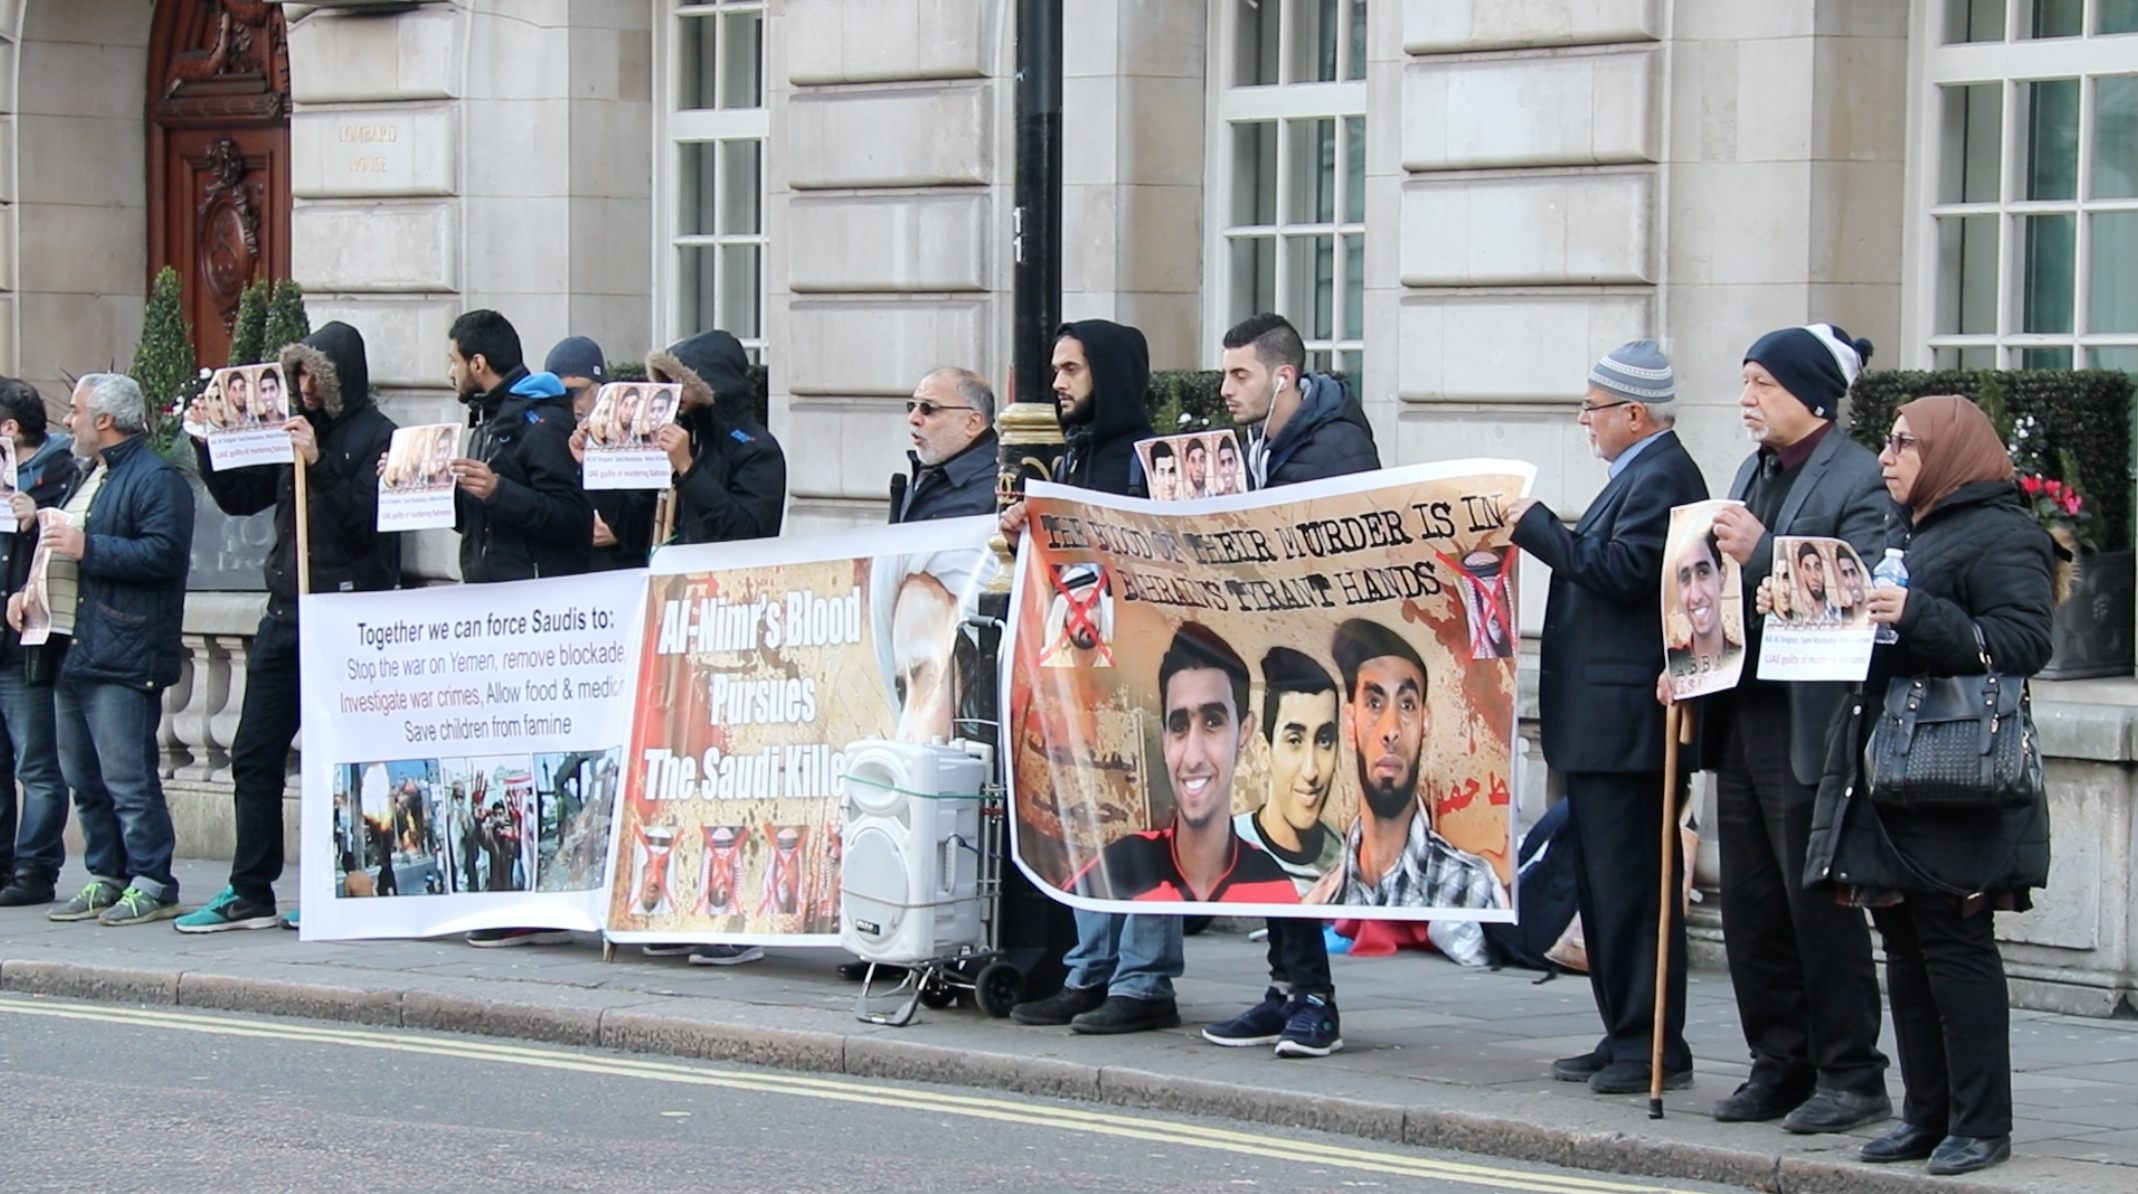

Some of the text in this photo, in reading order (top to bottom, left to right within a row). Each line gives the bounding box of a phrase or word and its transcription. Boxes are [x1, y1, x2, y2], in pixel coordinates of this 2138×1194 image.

[338, 125, 399, 143] LOMBARD
[349, 156, 389, 174] HOUSE
[1040, 514, 1092, 549] THE
[1151, 531, 1184, 564] OF
[1182, 528, 1278, 564] THEIR
[1274, 510, 1413, 560] MURDER
[1412, 501, 1456, 540] IS
[1460, 493, 1506, 533] IN
[1223, 573, 1336, 612] TYRANT
[1333, 560, 1442, 605] HANDS
[357, 606, 614, 651] Together we can force Saudis to:
[657, 584, 861, 656] Al-Nimr's Blood
[347, 658, 377, 683] Stop
[379, 656, 399, 679] the
[402, 657, 427, 677] war
[429, 656, 446, 675] on
[449, 651, 498, 674] Yemen,
[502, 648, 556, 670] remove
[340, 691, 408, 716] Investigate
[410, 691, 434, 713] war
[437, 684, 484, 709] crimes,
[486, 681, 521, 704] Allow
[525, 677, 558, 702] food
[562, 677, 573, 700] &
[710, 672, 817, 727] Pursues
[404, 711, 572, 743] Save children from famine
[643, 743, 847, 801] The Saudi Kille
